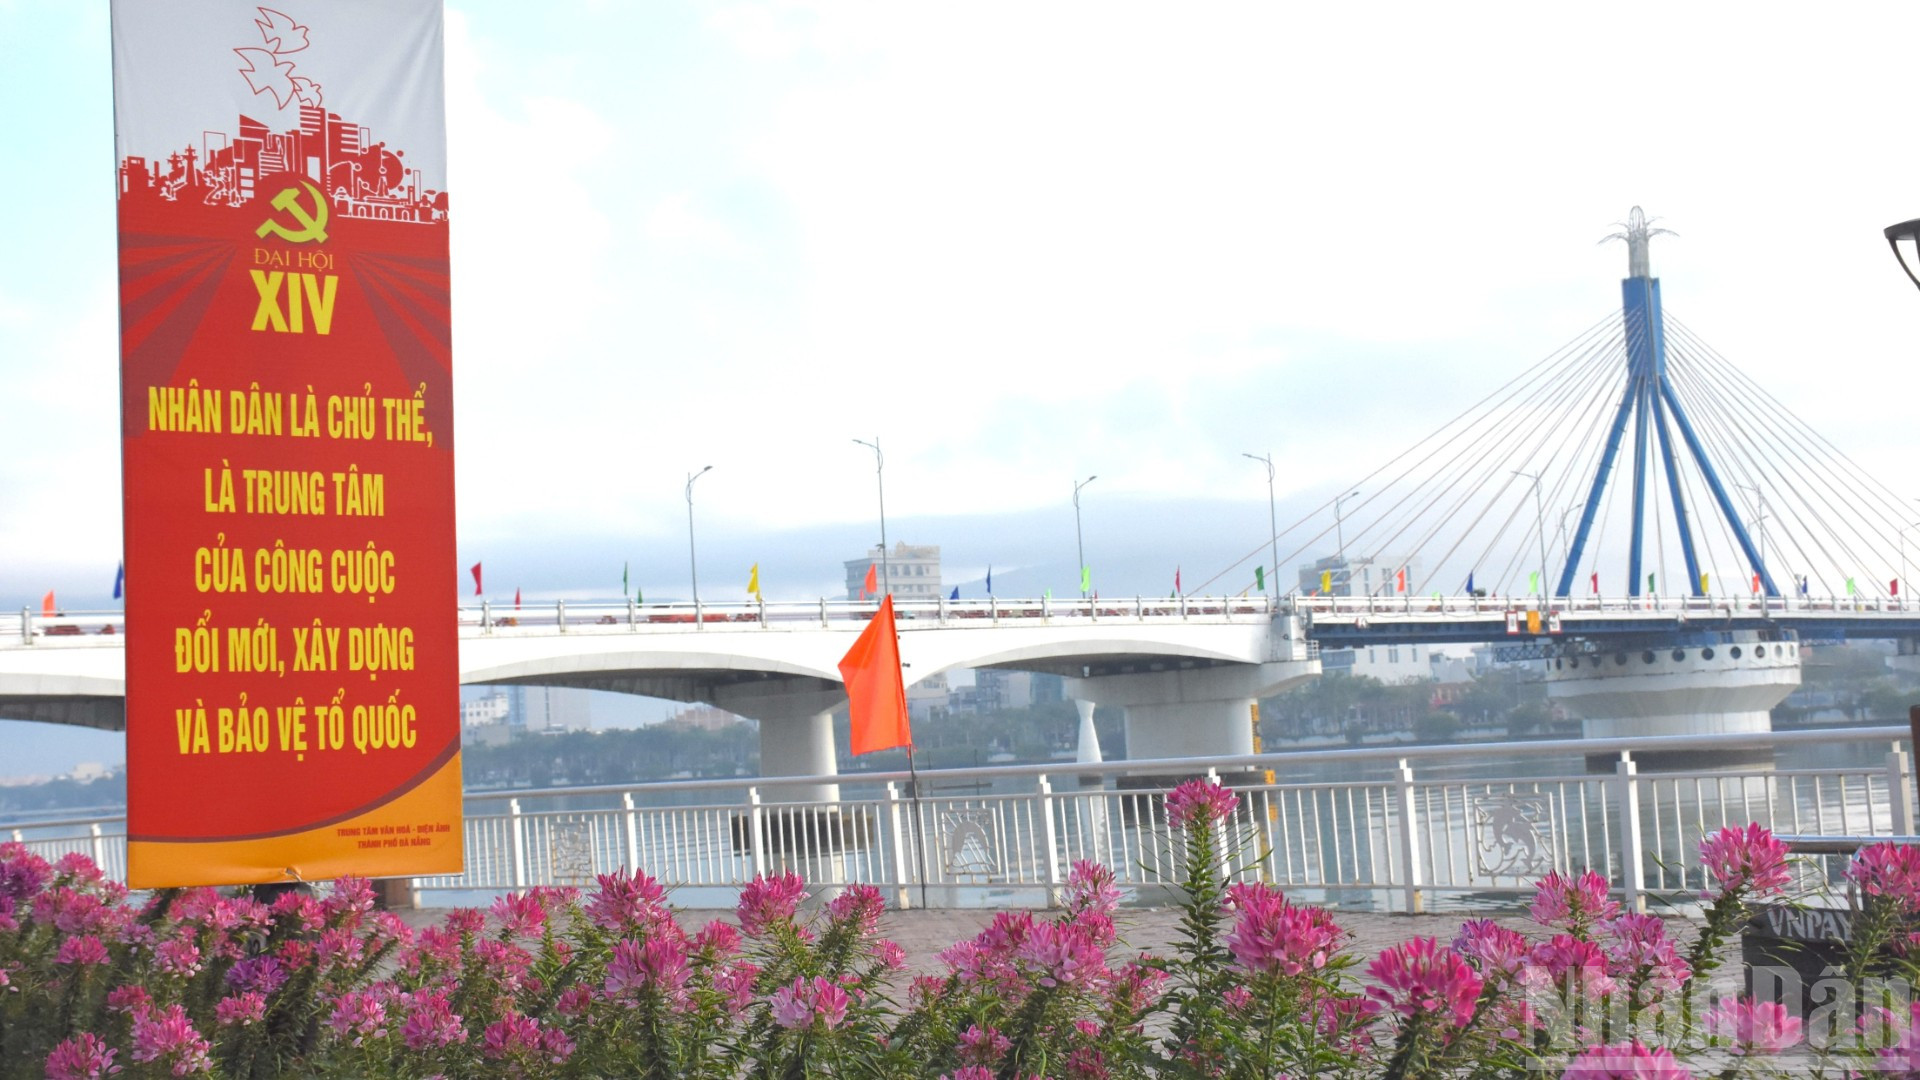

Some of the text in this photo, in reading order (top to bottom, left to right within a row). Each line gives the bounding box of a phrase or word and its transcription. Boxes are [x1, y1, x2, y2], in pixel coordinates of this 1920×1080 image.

[254, 248, 333, 272] ĐẠI HỘI
[249, 269, 339, 335] XIV
[148, 378, 433, 447] NHÂN DÂN LÀ CHỦ THỂ,
[205, 459, 384, 516] LÀ TRUNG TÂM
[195, 532, 395, 603] CỦA CÔNG CUỘC
[175, 609, 415, 681] ĐỔI MỚI, XÂY DỰNG
[175, 687, 417, 761] VÀ BẢO VỆ TỔ QUỐC
